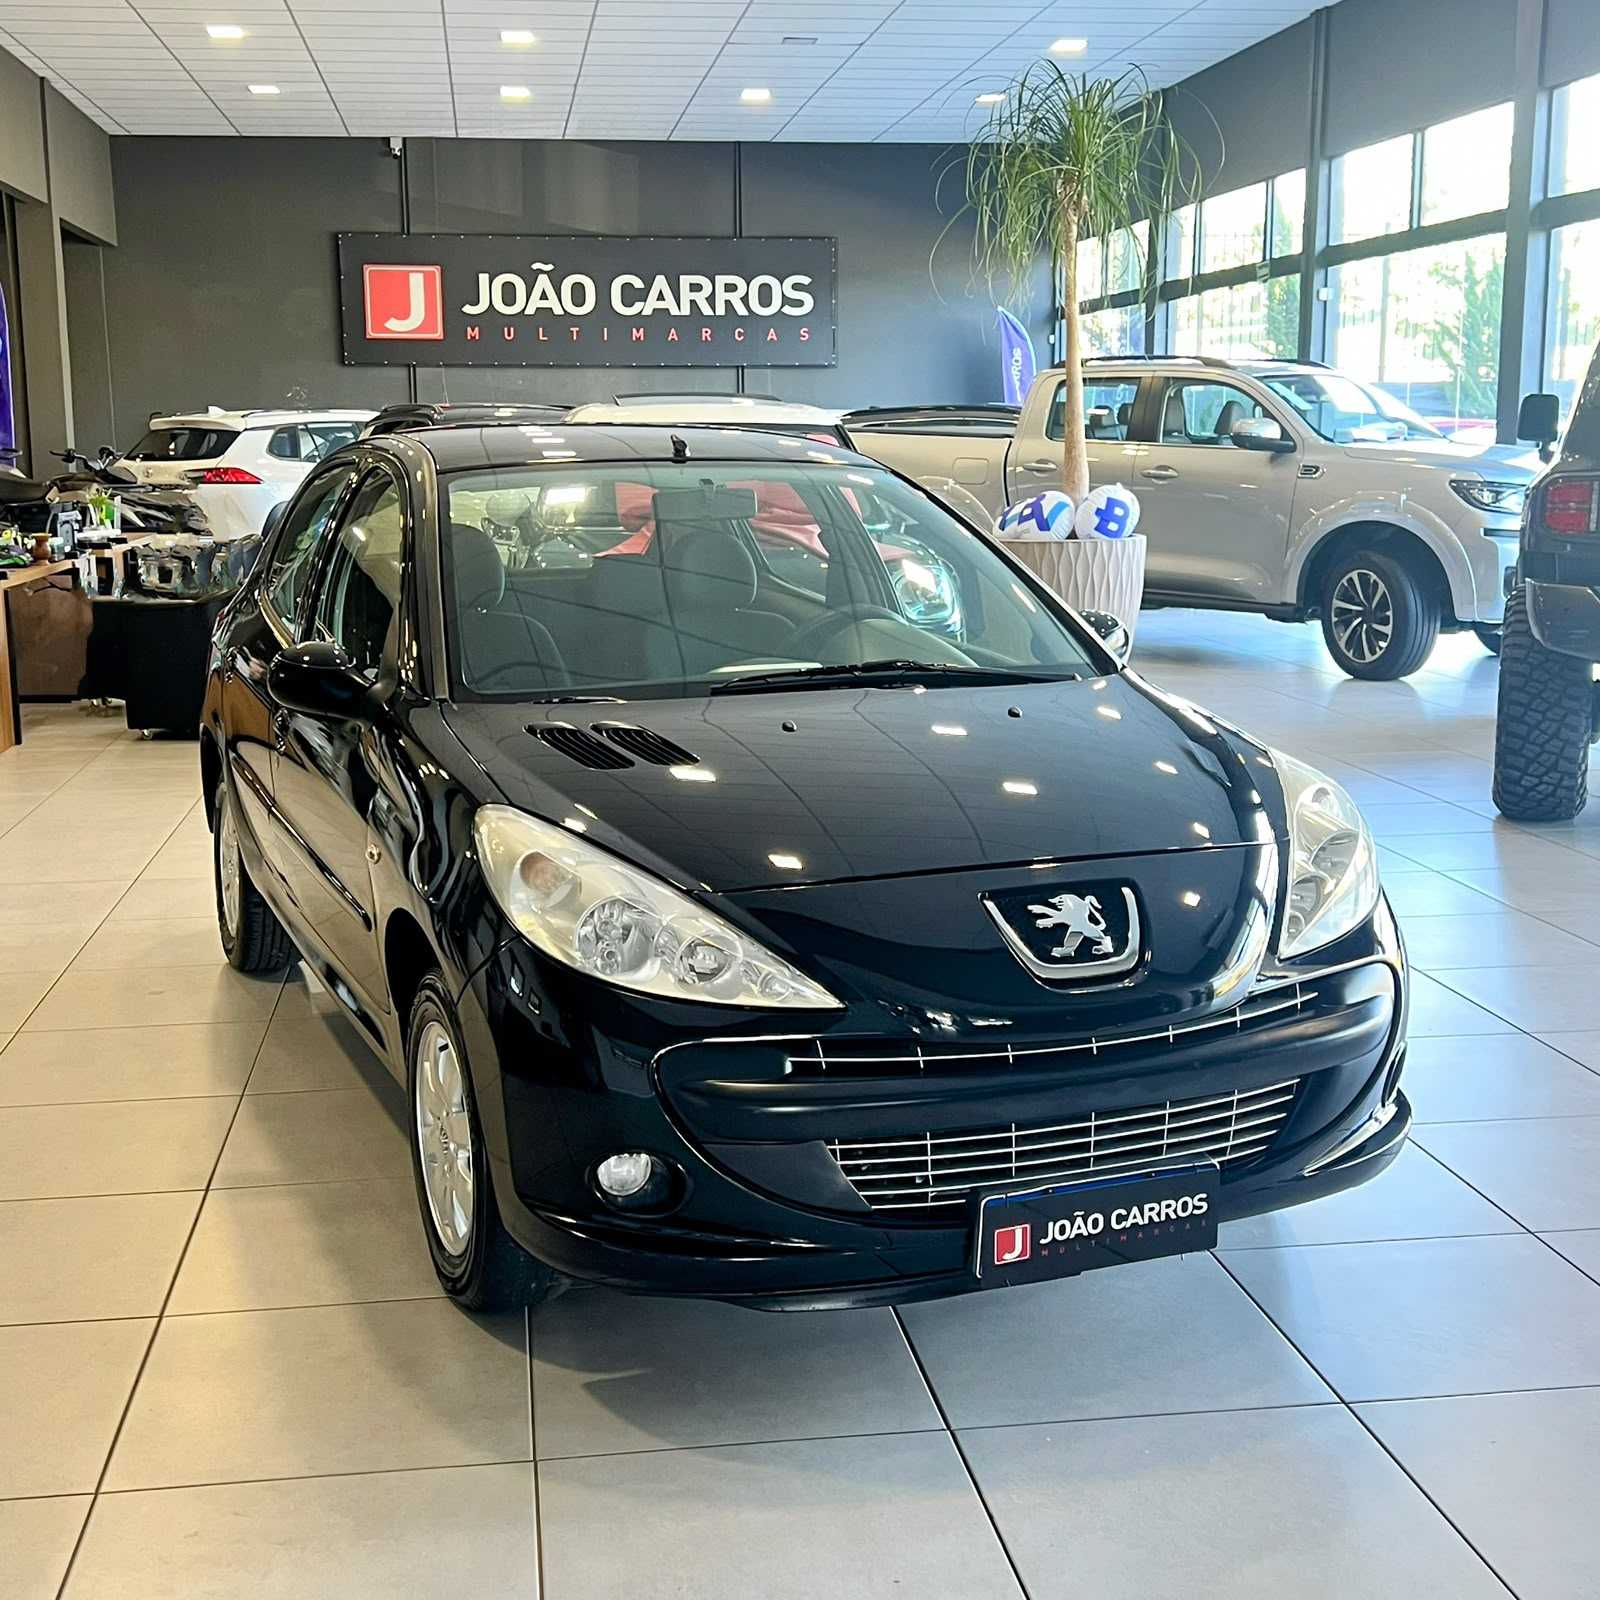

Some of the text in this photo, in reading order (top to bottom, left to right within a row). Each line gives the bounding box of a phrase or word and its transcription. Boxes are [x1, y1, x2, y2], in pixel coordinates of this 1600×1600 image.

[384, 272, 425, 332] J
[461, 262, 815, 317] JOÃO CARROS
[466, 326, 810, 342] MULTIMARCAS
[1002, 1227, 1023, 1260] J
[1039, 1193, 1208, 1245] JOÃO CARROS
